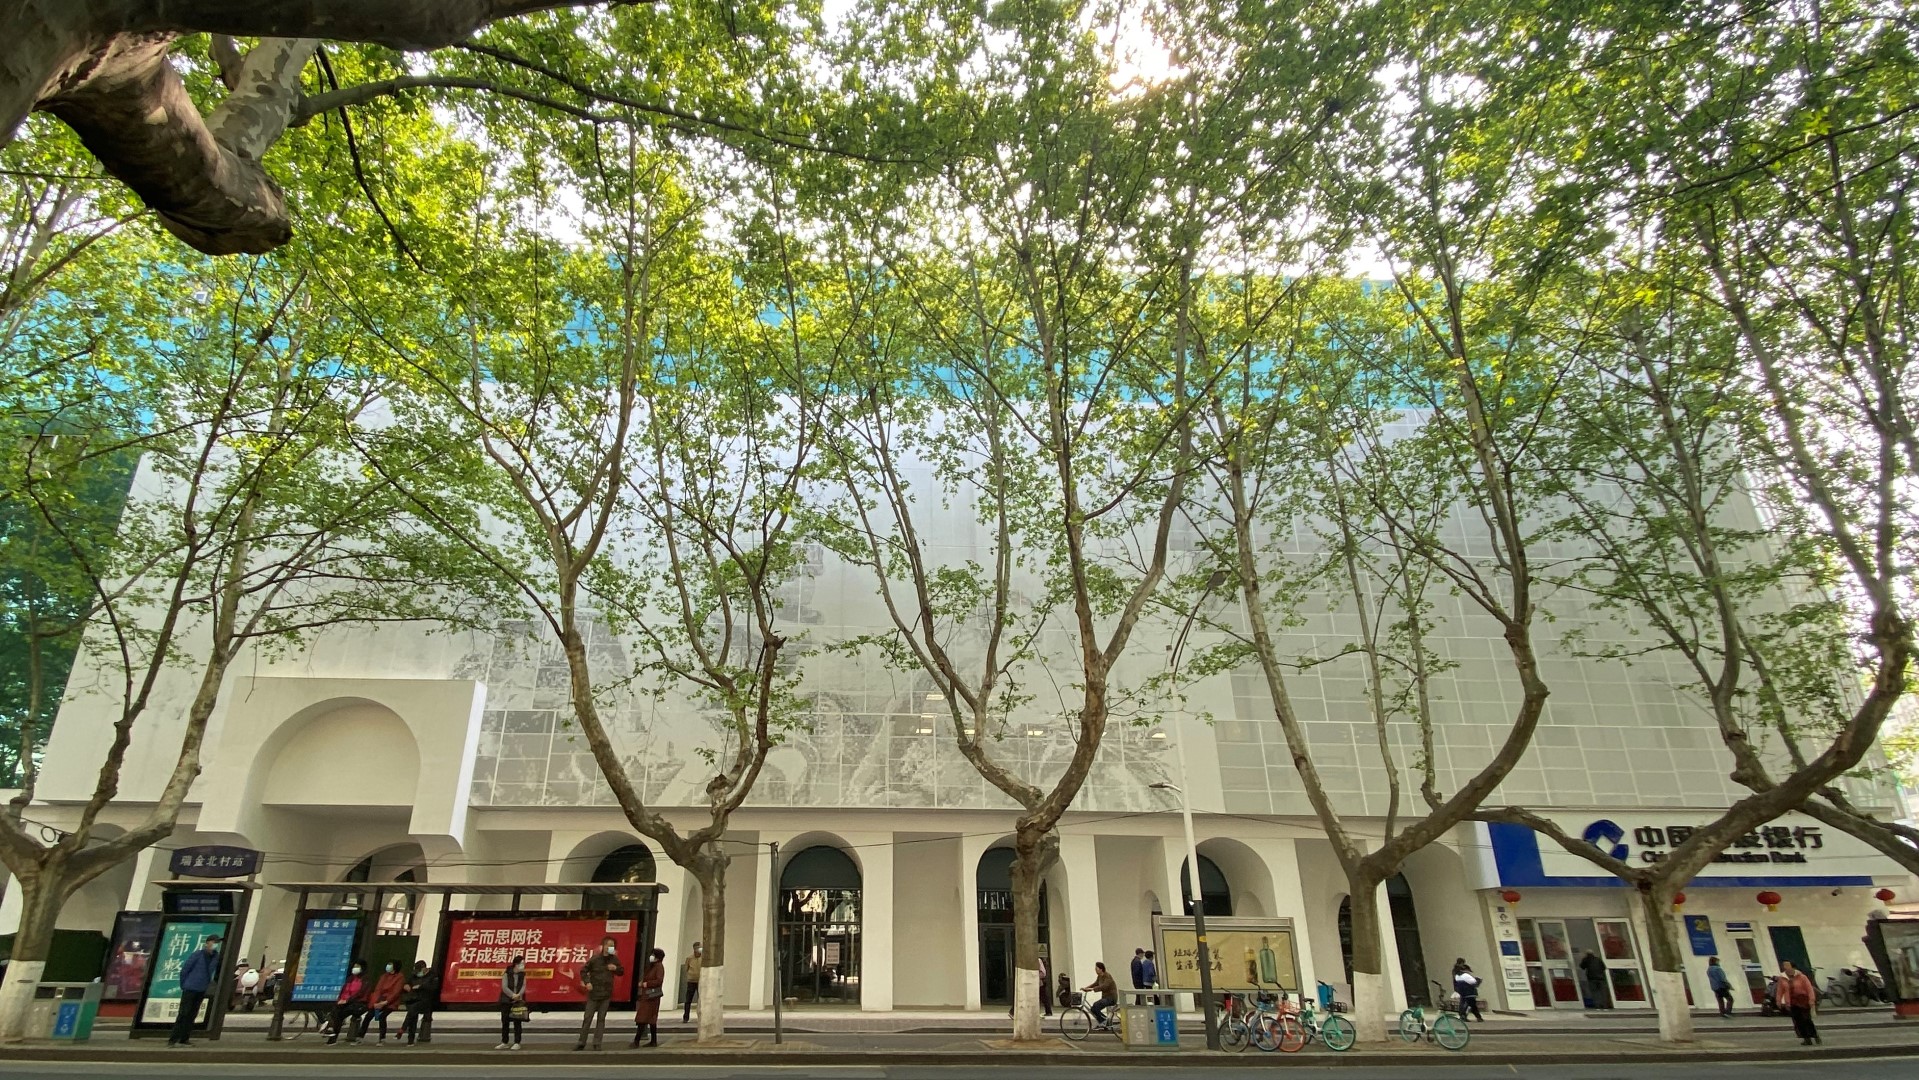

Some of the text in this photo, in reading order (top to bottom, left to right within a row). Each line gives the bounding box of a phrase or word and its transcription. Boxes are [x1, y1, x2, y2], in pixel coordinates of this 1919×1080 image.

[1633, 825, 1823, 849] 中国设银行
[180, 854, 244, 868] 瑞金北村站
[463, 929, 543, 945] 学而思网校
